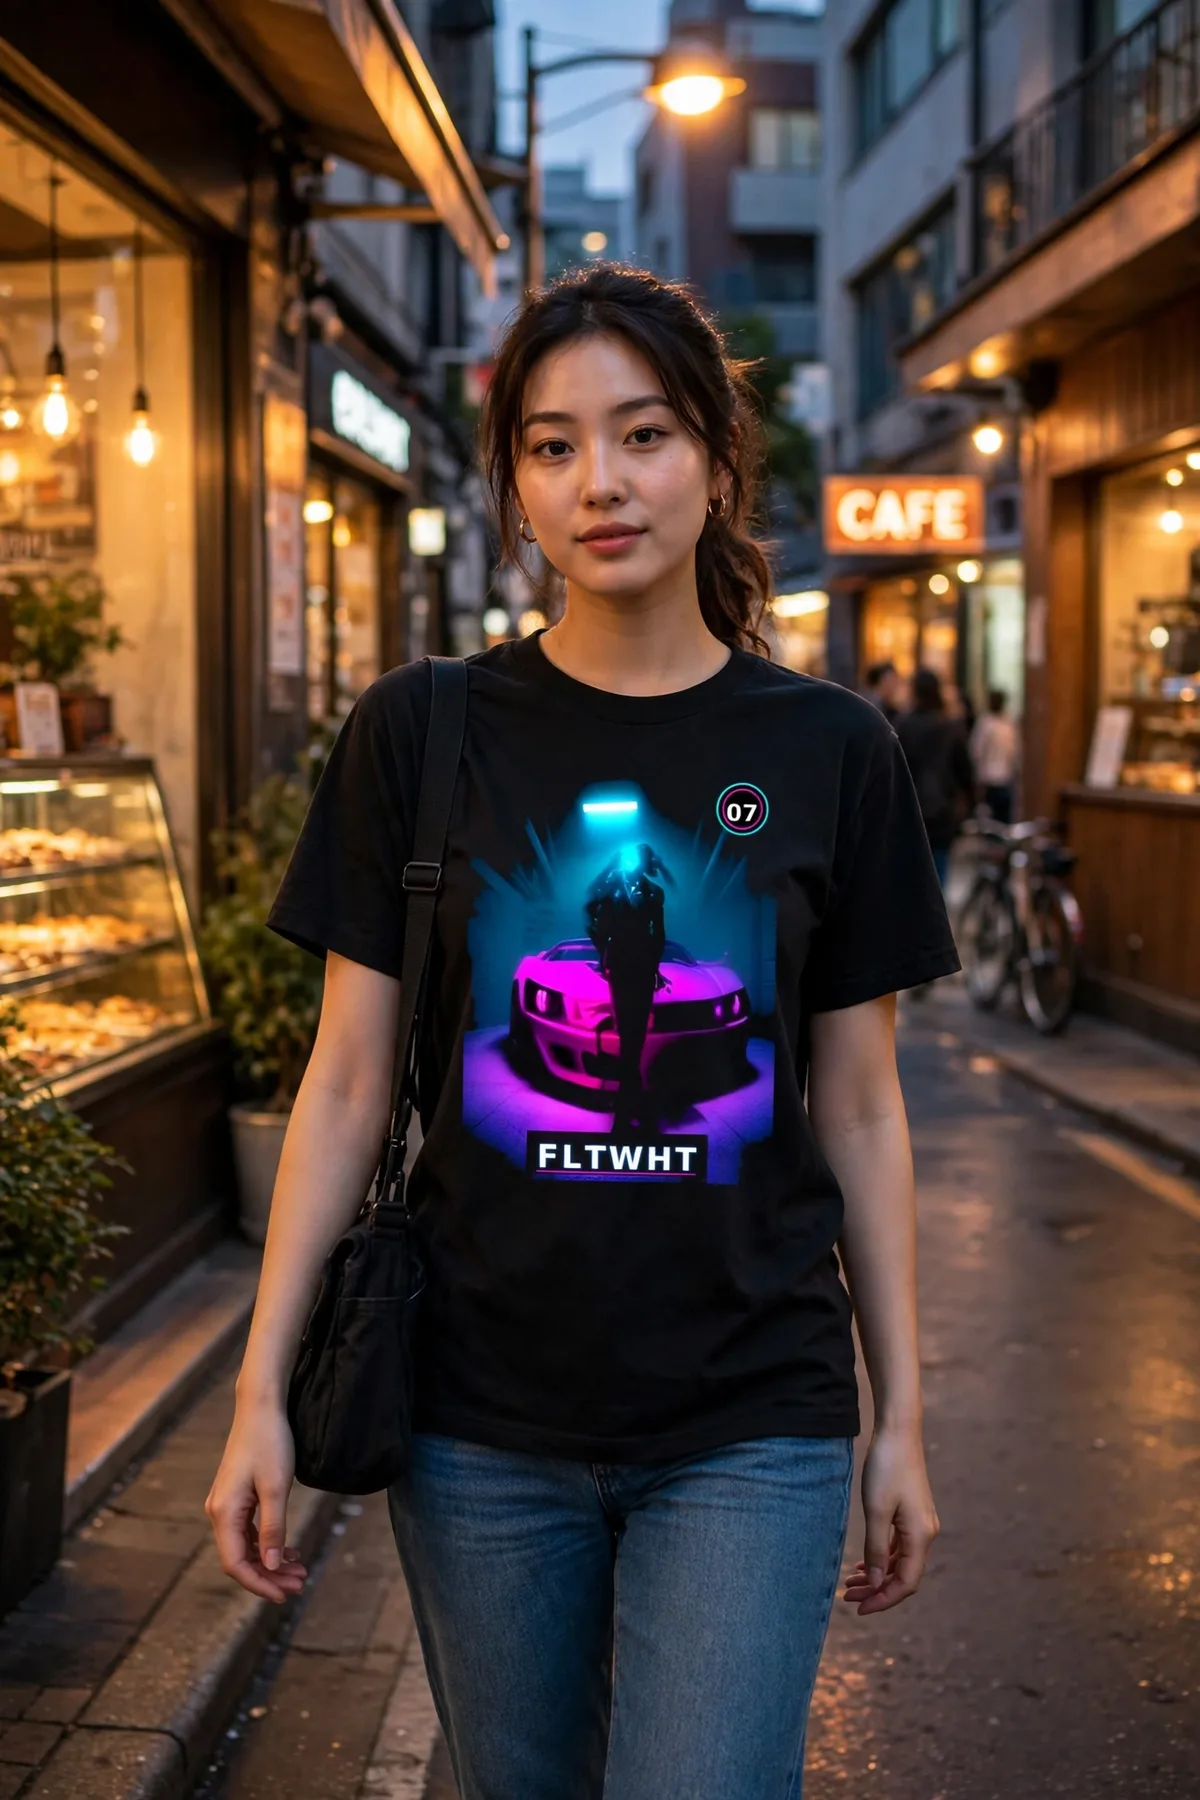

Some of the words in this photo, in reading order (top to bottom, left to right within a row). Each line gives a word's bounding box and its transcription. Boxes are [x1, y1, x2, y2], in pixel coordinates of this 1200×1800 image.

[836, 488, 968, 542] CAFE
[727, 803, 757, 822] 07
[538, 1143, 697, 1172] FLTWHT
